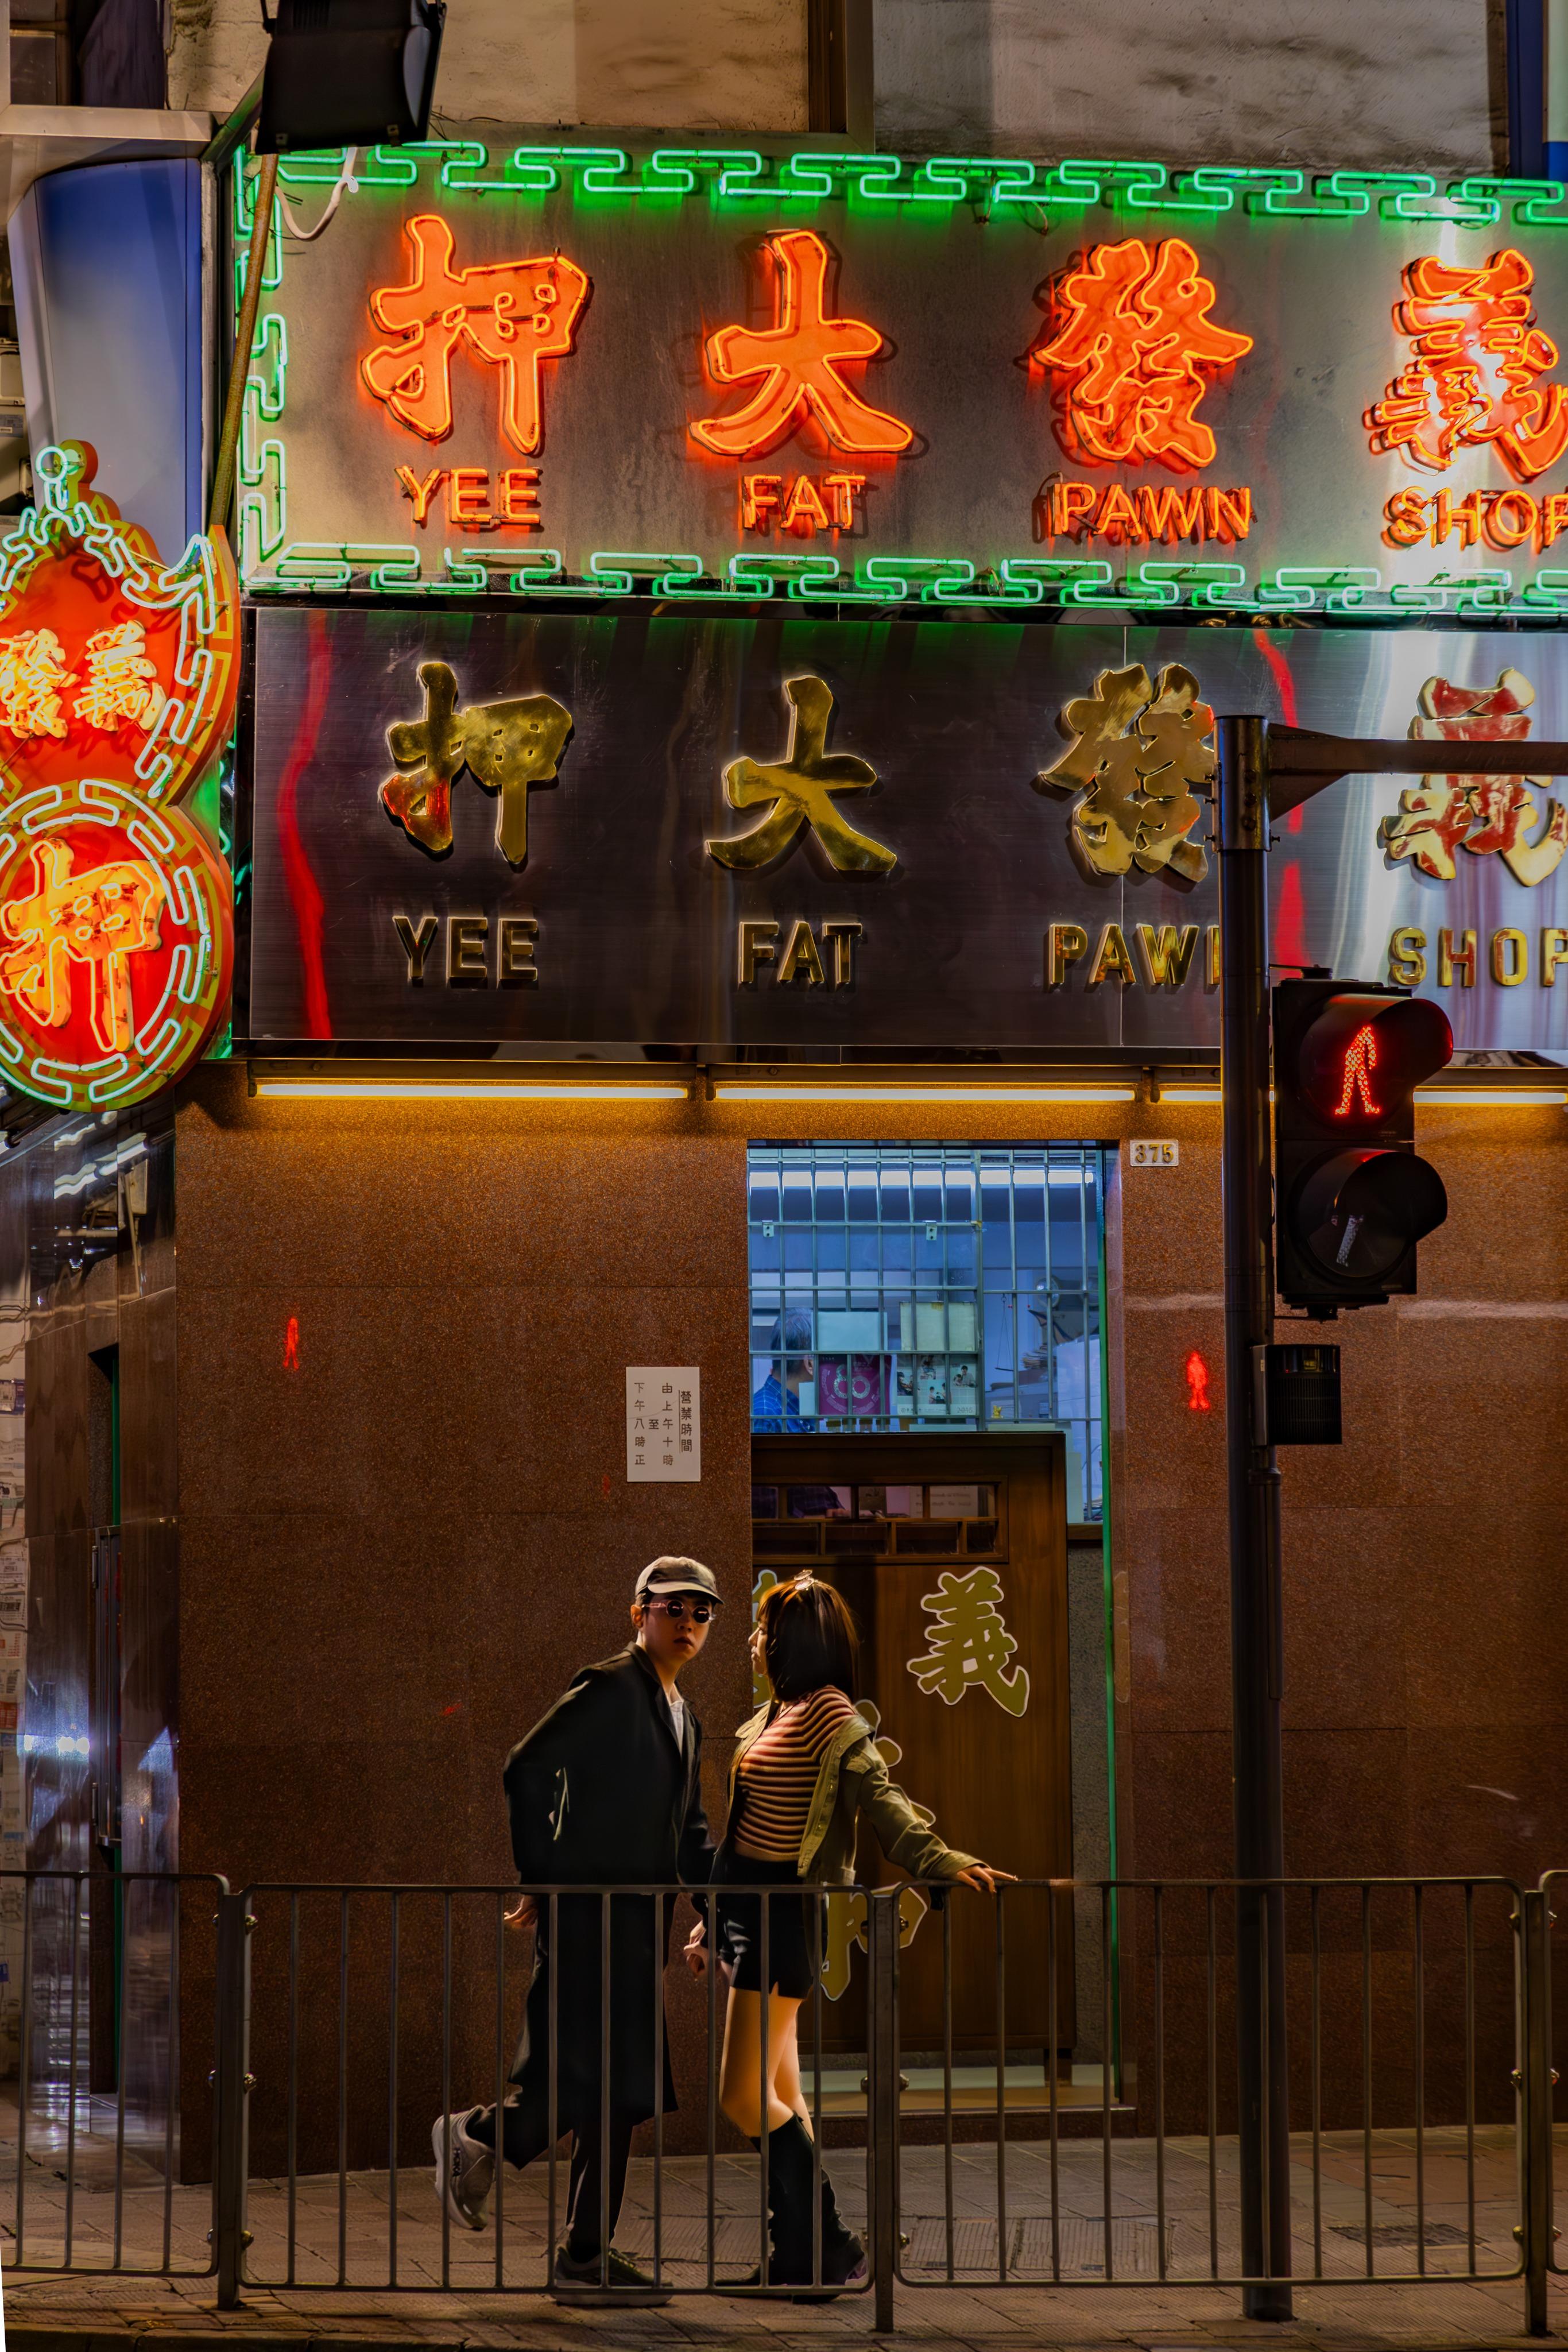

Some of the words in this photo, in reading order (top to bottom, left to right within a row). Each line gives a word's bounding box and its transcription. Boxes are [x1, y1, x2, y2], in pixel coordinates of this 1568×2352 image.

[395, 465, 541, 526] YEE
[742, 473, 866, 531] FAT
[1052, 483, 1252, 539] PAWN
[0, 838, 168, 1053] 押
[392, 916, 539, 981] YEE
[738, 921, 863, 984] FAT
[1389, 927, 1568, 987] SHOP
[1135, 1143, 1174, 1163] 375
[634, 1382, 645, 1465] 下午八時正
[648, 1419, 659, 1430] 至
[662, 1382, 673, 1465] 由上午十時
[680, 1391, 692, 1452] 營業時間
[906, 1566, 1031, 1717] 義
